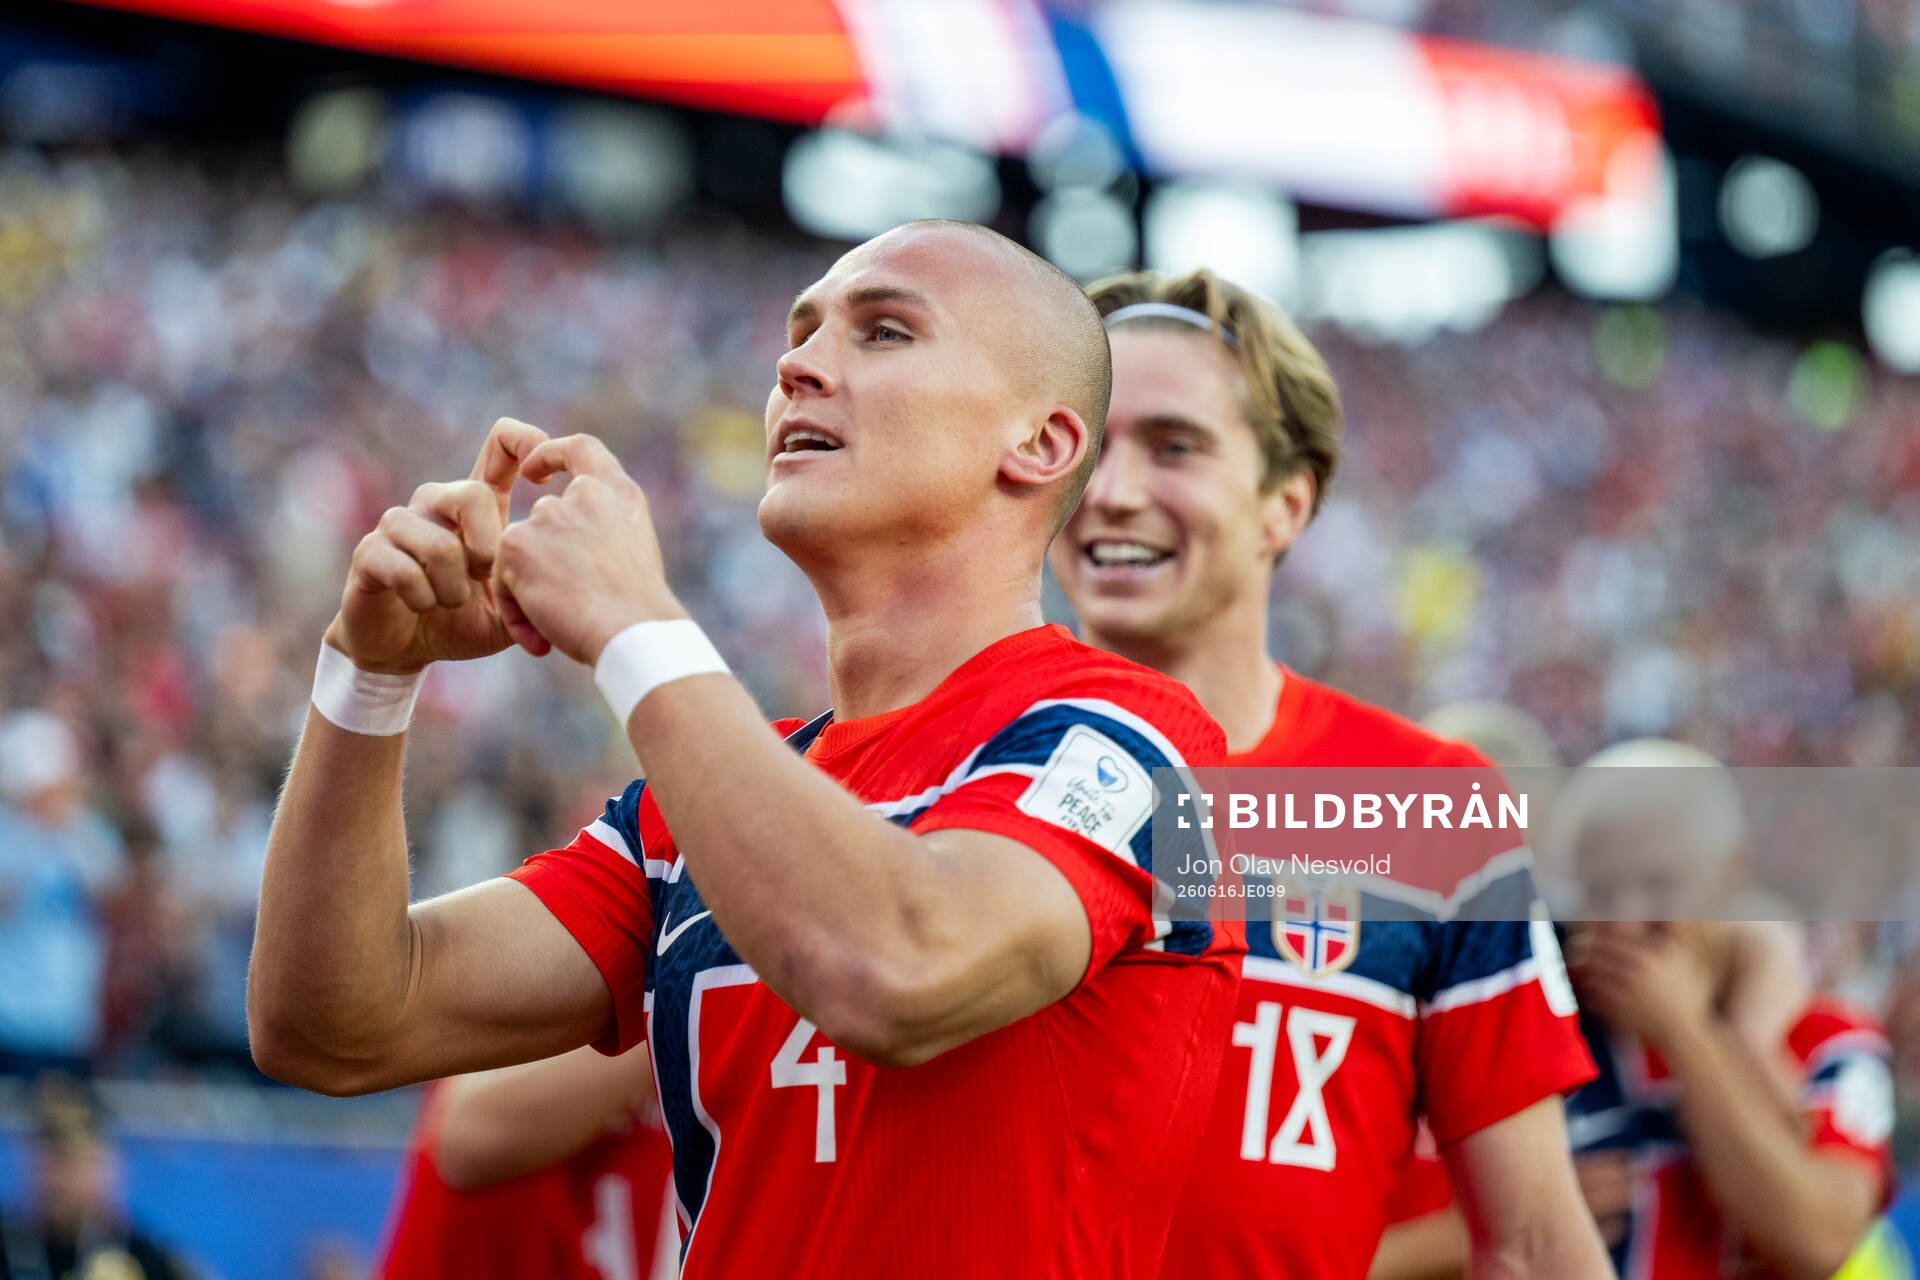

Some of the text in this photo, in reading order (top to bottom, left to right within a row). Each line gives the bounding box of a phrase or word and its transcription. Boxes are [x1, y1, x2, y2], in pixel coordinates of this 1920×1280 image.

[1058, 792, 1103, 839] PEACE
[770, 1017, 846, 1163] 4
[1232, 1001, 1357, 1172] 18
